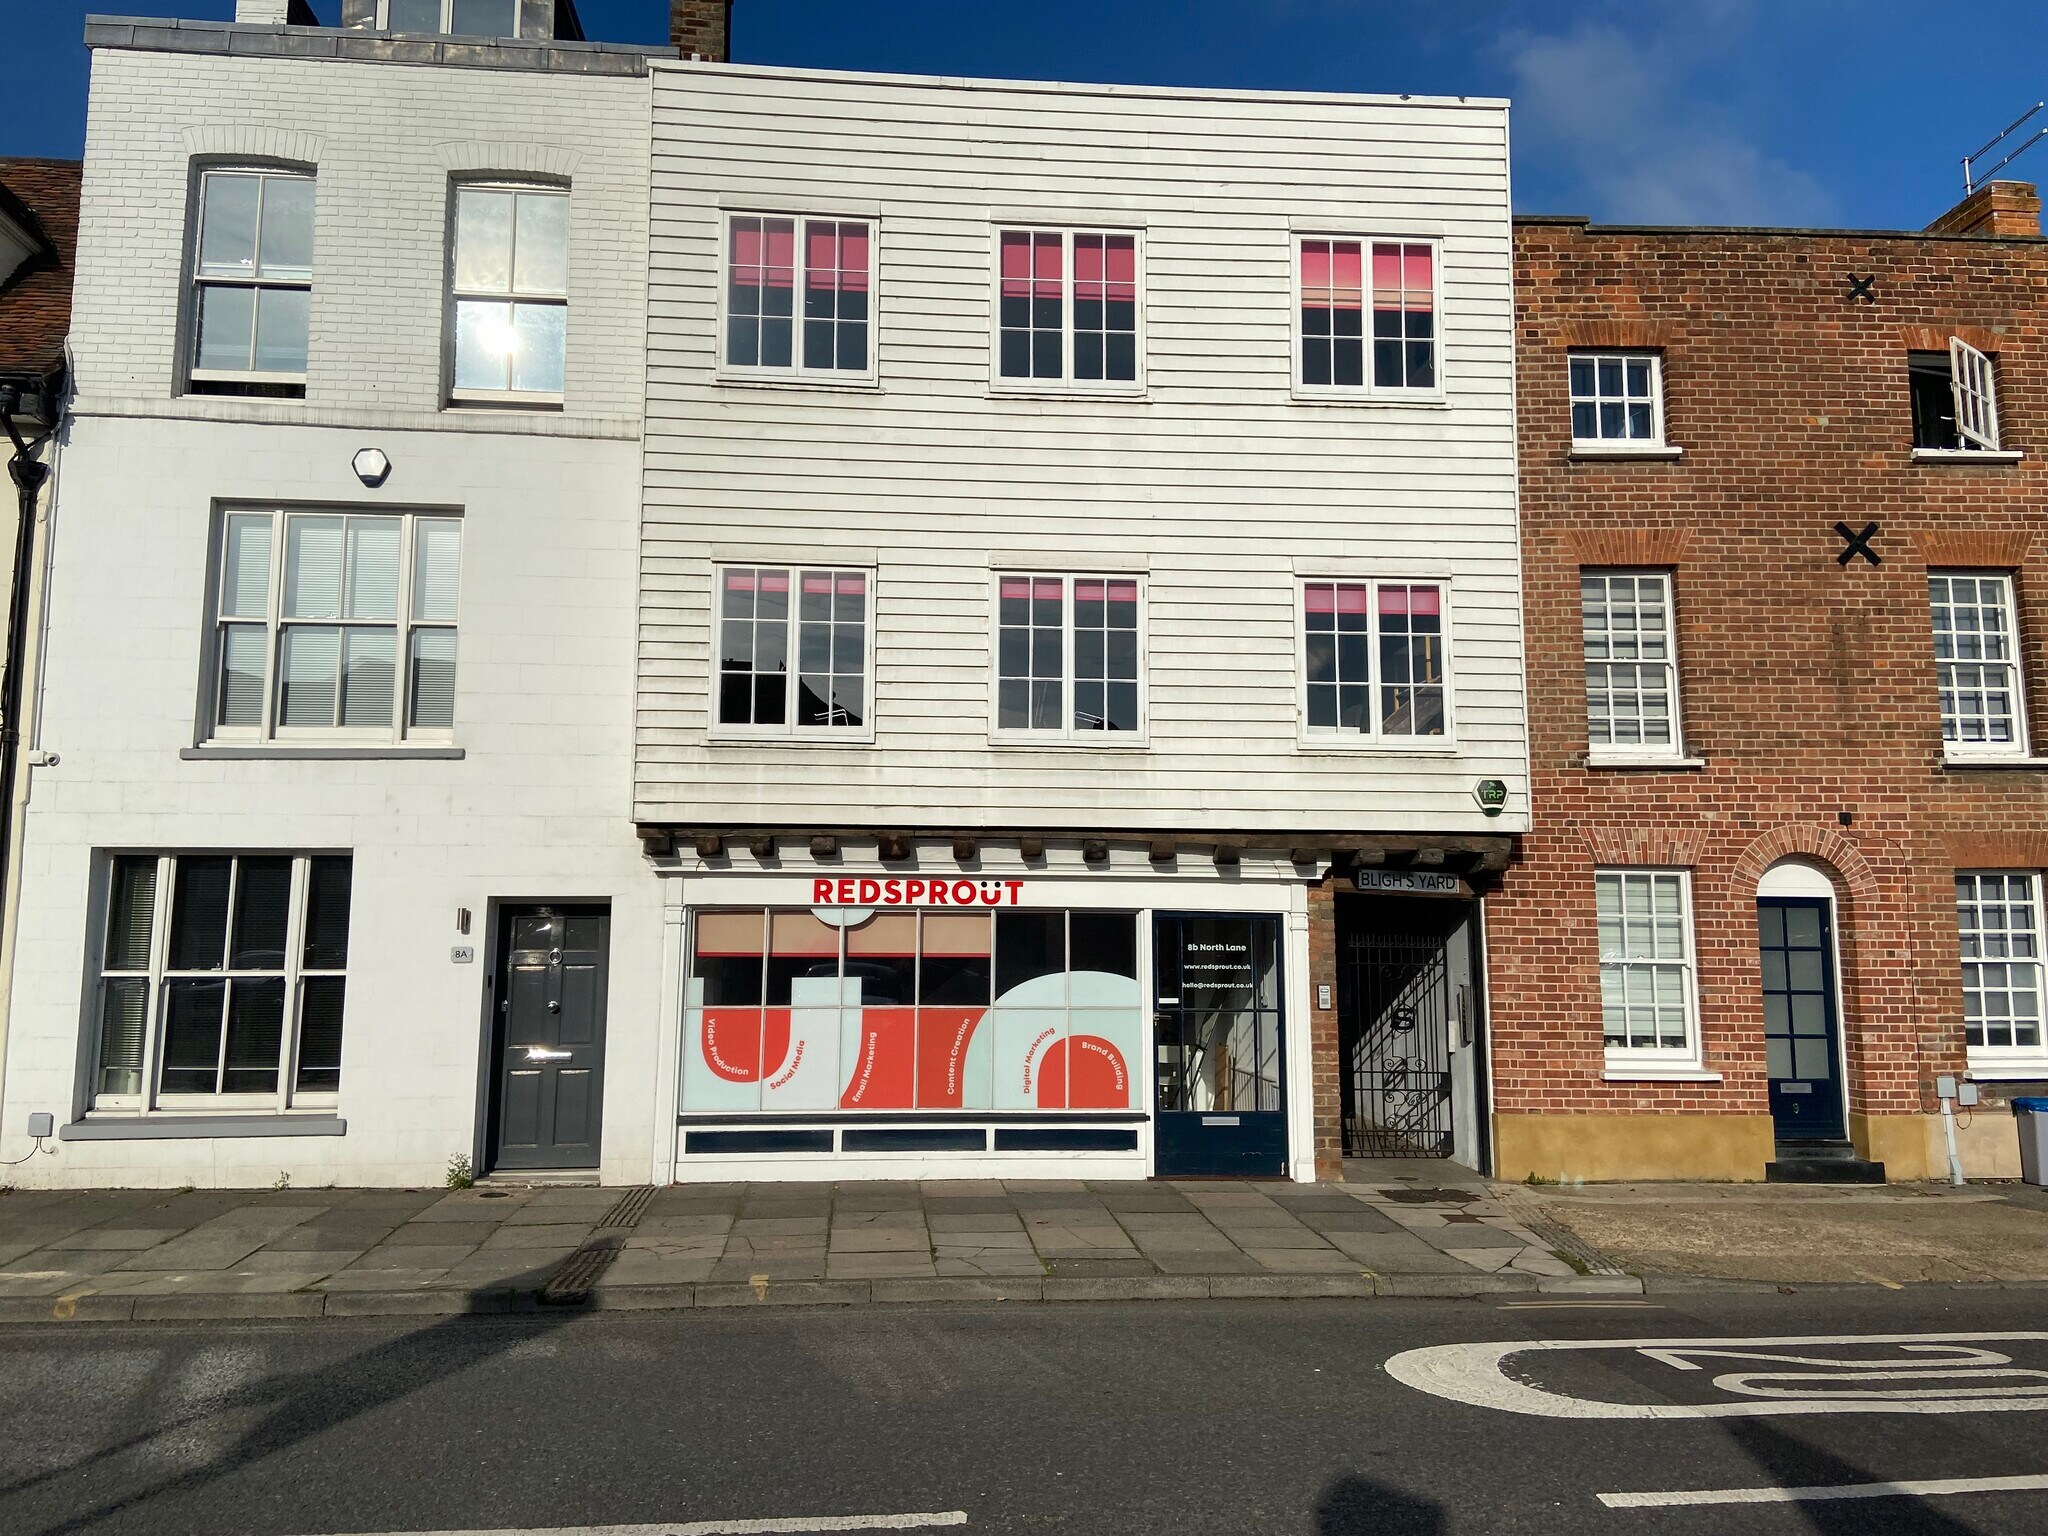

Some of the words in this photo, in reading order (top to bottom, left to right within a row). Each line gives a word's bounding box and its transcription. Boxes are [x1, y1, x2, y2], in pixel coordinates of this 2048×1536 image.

[1482, 790, 1504, 799] TRP
[1361, 872, 1415, 888] BLIGH'S
[1418, 874, 1456, 890] YARD
[455, 950, 468, 958] 8A
[1187, 943, 1198, 952] 8b
[1199, 943, 1224, 952] North
[1225, 943, 1247, 952] Lane
[1183, 963, 1251, 971] www.redsprout.co.uk
[1182, 982, 1254, 990] hello@redsprout.co.uk
[707, 1018, 716, 1046] Video
[950, 1018, 971, 1057] Creation
[1025, 1027, 1056, 1064] Marketing
[710, 1046, 749, 1076] Production
[770, 1069, 795, 1090] Social
[792, 1039, 805, 1070] Media
[852, 1079, 868, 1103] Email
[863, 1031, 878, 1079] Marketing
[1081, 1041, 1108, 1056] Brand
[1106, 1053, 1124, 1091] Building
[947, 1057, 957, 1095] Content
[1023, 1065, 1032, 1094] Digital
